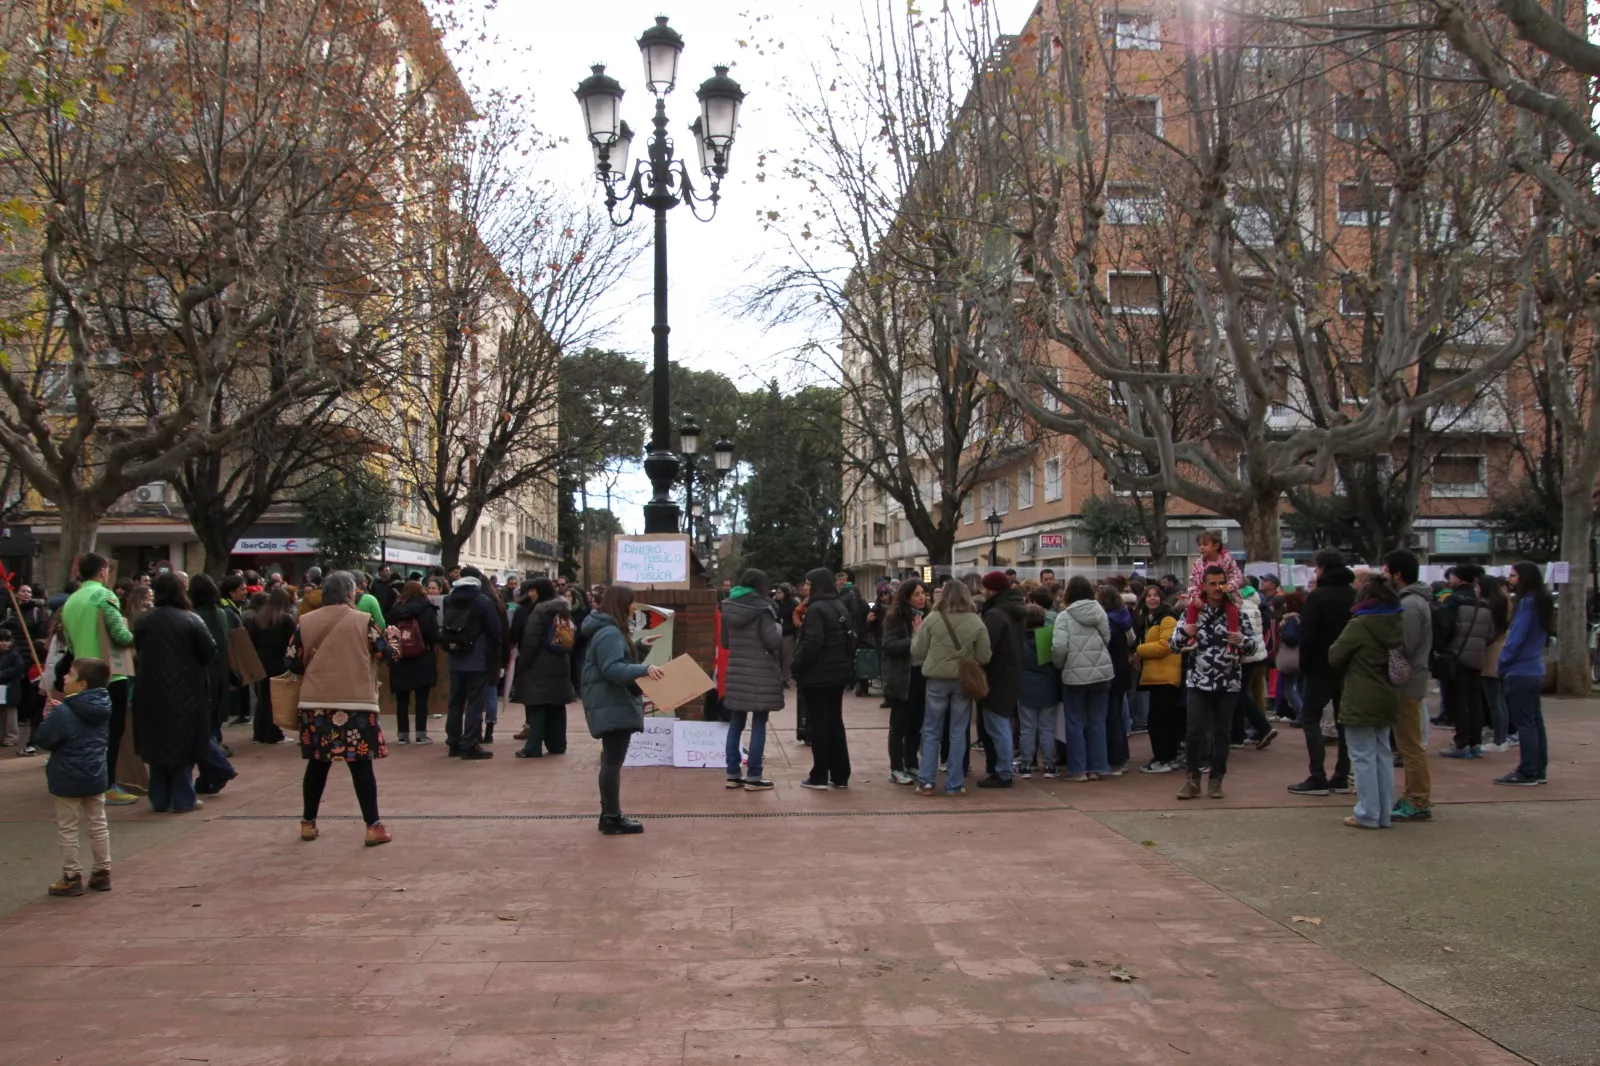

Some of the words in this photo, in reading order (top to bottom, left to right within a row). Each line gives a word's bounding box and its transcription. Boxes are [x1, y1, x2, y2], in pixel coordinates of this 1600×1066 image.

[1042, 536, 1061, 545] ALFA
[241, 541, 277, 550] iberCaja
[624, 543, 662, 555] DINERO
